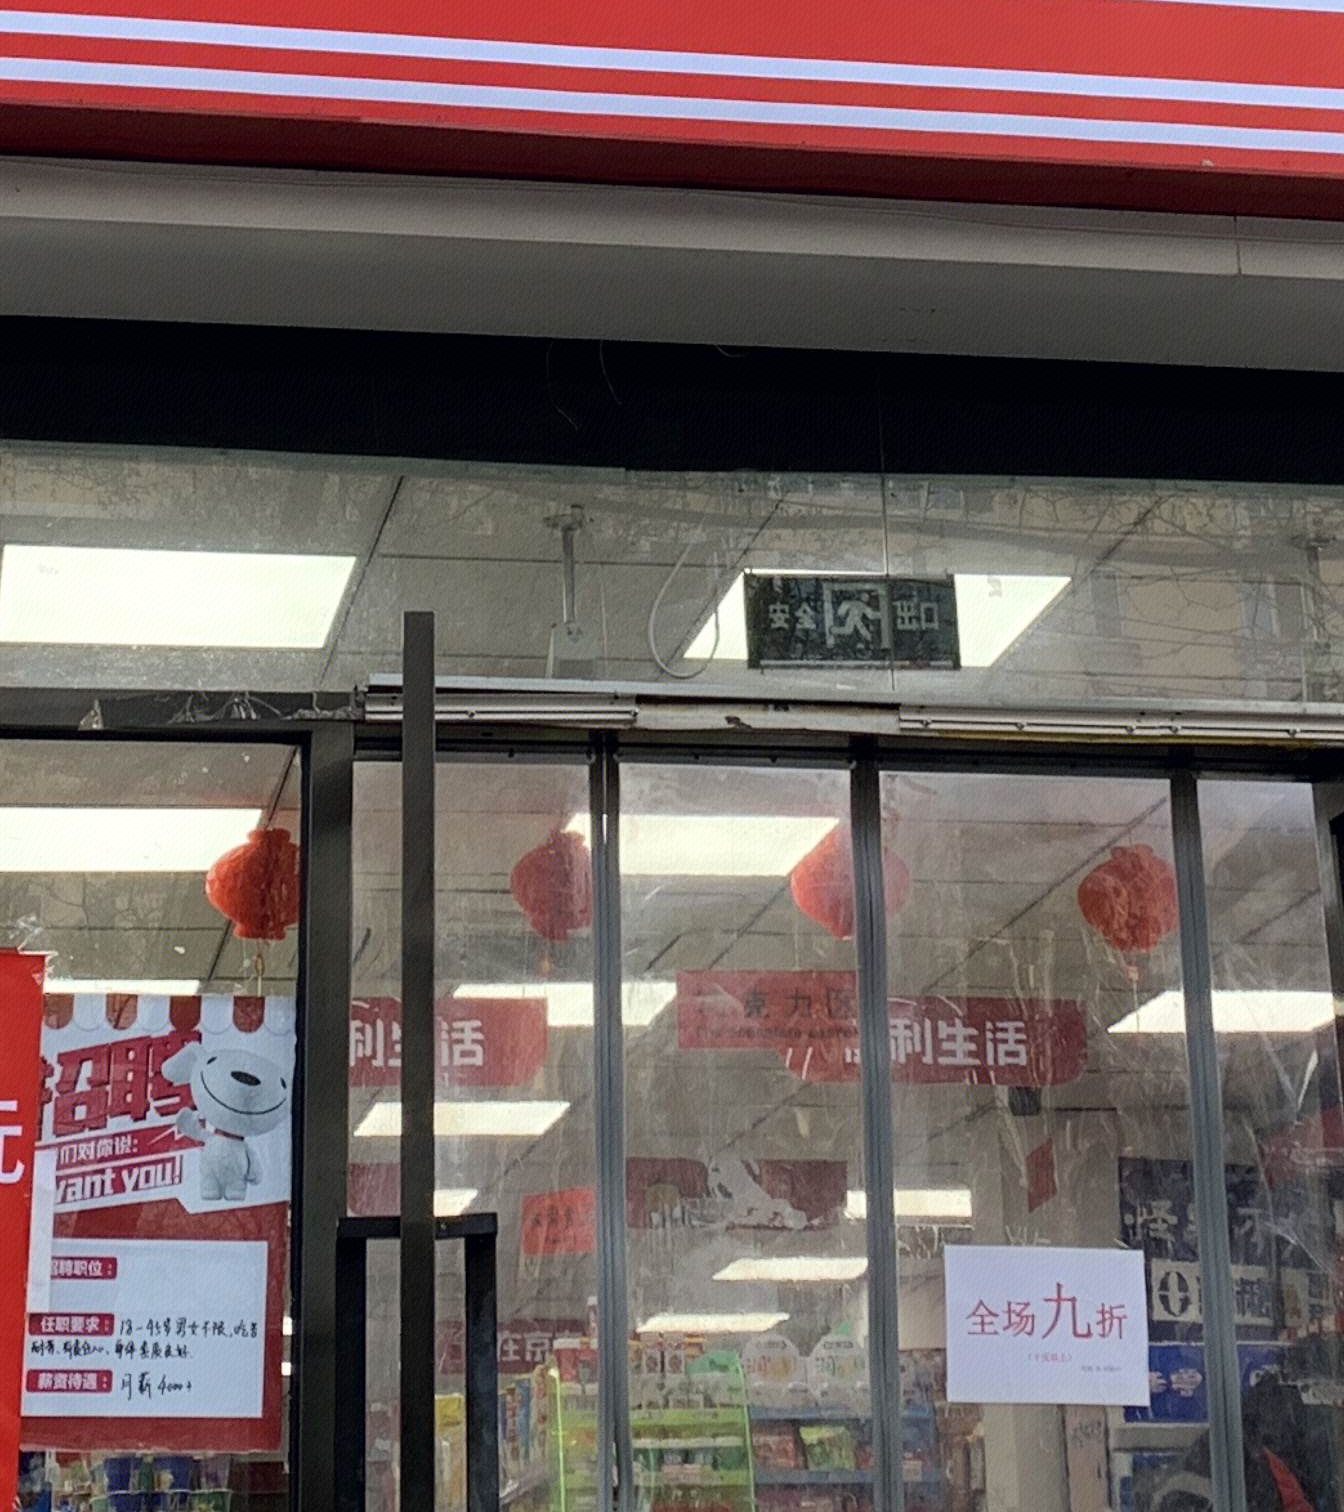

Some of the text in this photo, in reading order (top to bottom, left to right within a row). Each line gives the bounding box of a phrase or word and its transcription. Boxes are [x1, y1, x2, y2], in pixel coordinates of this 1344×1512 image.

[768, 600, 941, 631] 安全 出口
[55, 1136, 139, 1166] 们对你说:
[121, 1154, 186, 1196] you!
[40, 1316, 110, 1334] 任职要求:
[965, 1281, 1128, 1340] 全场九折
